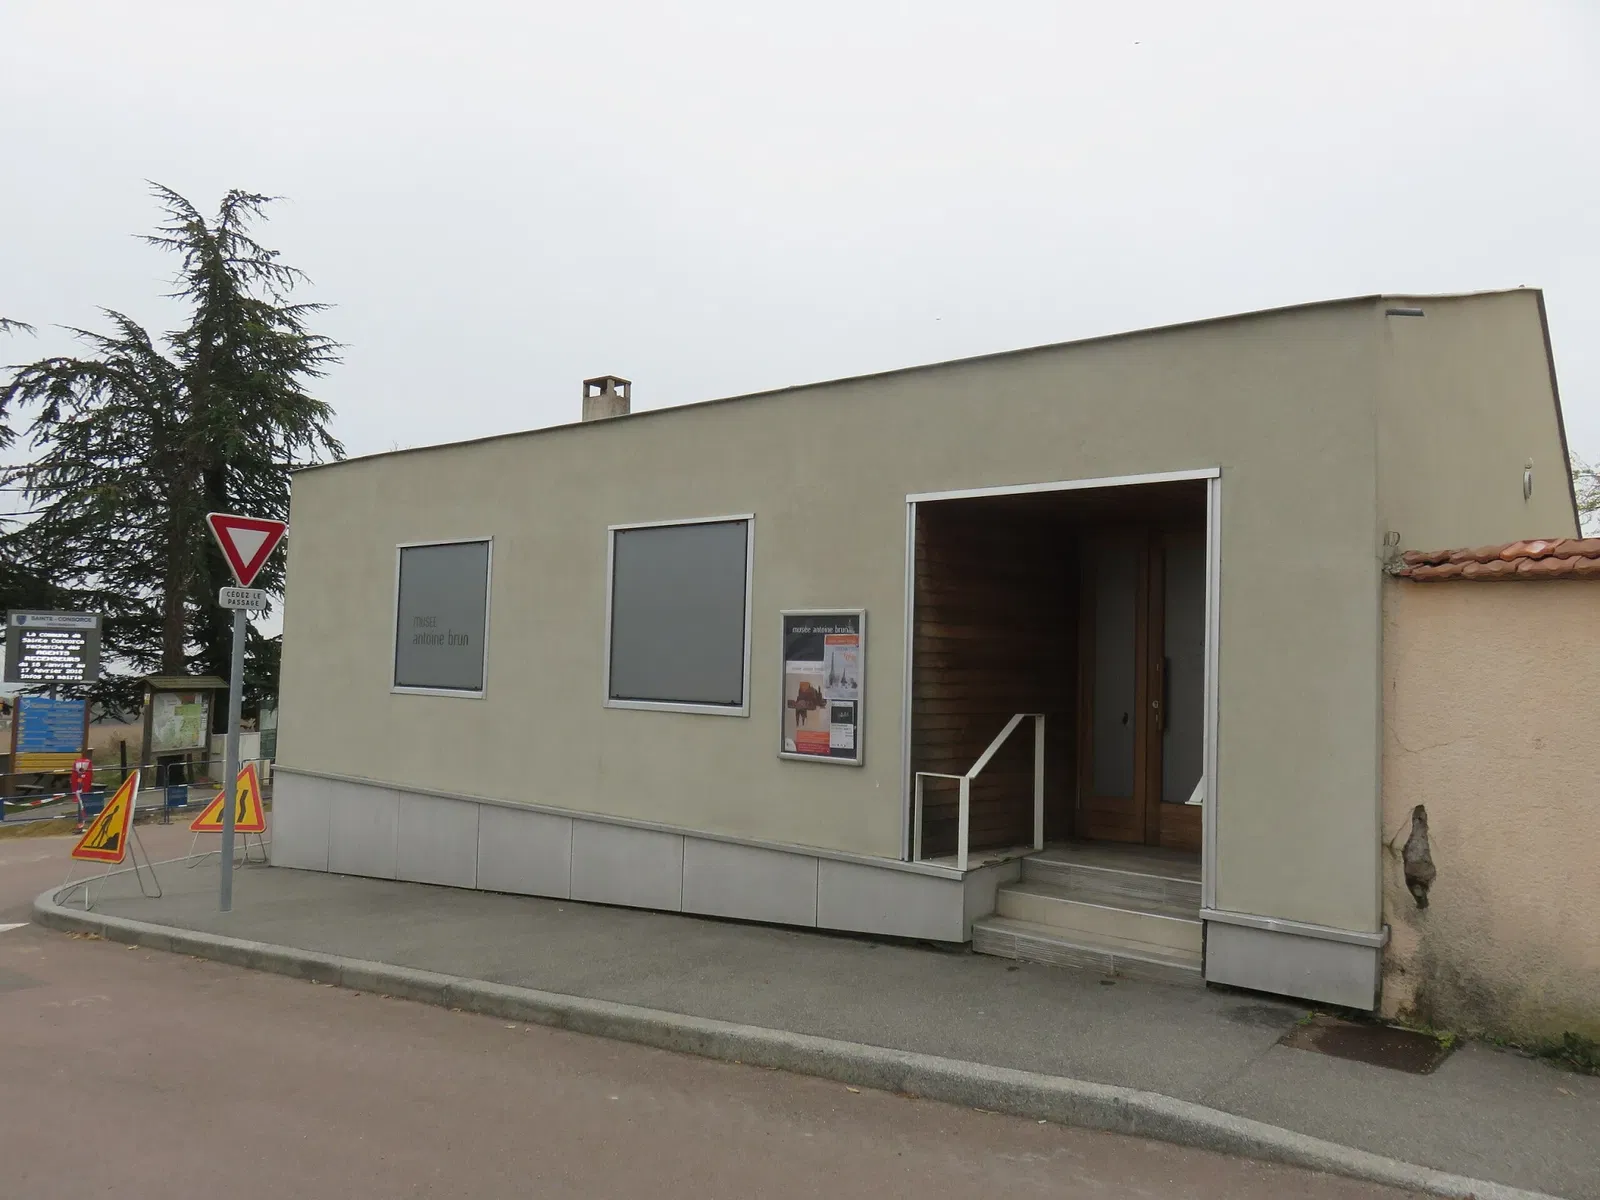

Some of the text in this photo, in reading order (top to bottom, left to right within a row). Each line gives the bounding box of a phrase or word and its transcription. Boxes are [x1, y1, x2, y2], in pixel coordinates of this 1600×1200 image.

[813, 625, 833, 633] antoine
[412, 629, 469, 646] antoine brun
